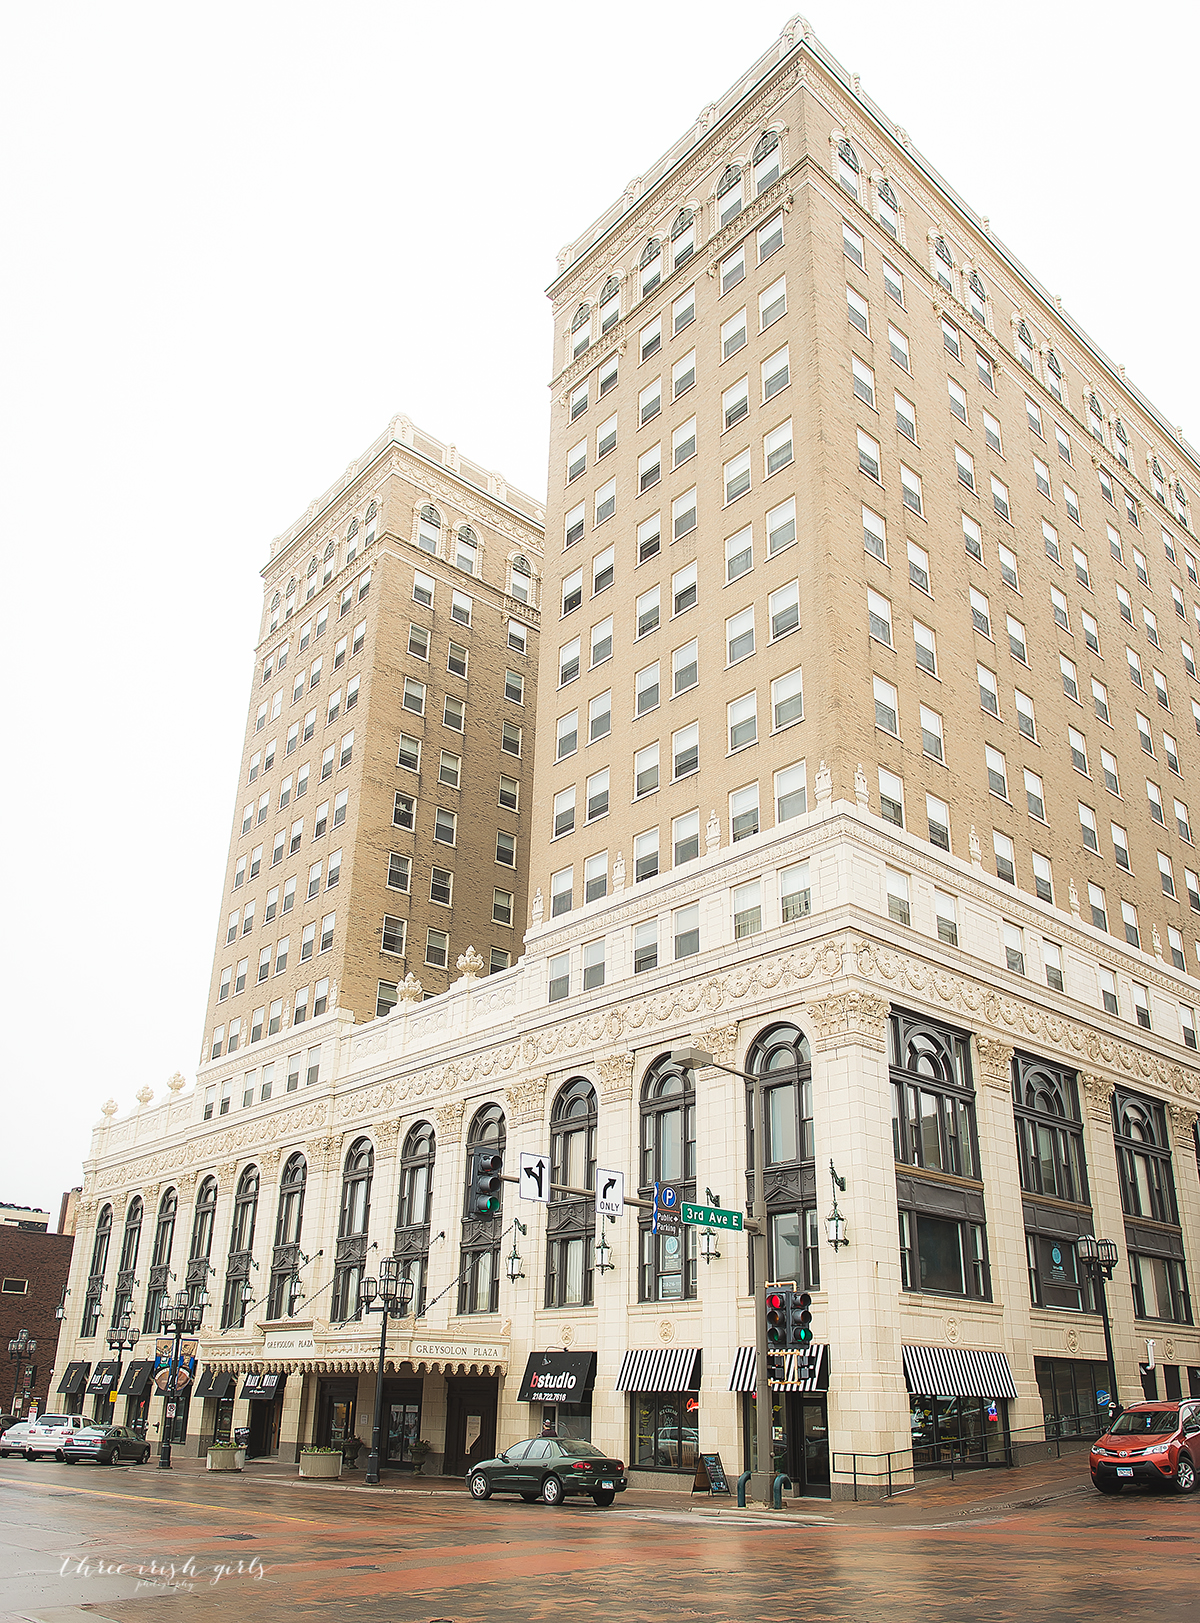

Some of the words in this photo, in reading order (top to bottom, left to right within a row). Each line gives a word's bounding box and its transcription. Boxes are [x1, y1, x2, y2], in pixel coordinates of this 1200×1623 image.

[666, 1189, 673, 1205] P
[599, 1200, 620, 1212] ONLY
[657, 1212, 674, 1222] Public
[686, 1207, 704, 1221] 3rd
[709, 1211, 728, 1225] Ave
[732, 1215, 739, 1227] E
[656, 1223, 677, 1235] Parking
[266, 1340, 295, 1349] GREYSOLON
[298, 1340, 314, 1348] PLAZA
[415, 1344, 468, 1356] GREYSOLON
[473, 1347, 499, 1357] PLAZA
[530, 1371, 577, 1389] bstudio
